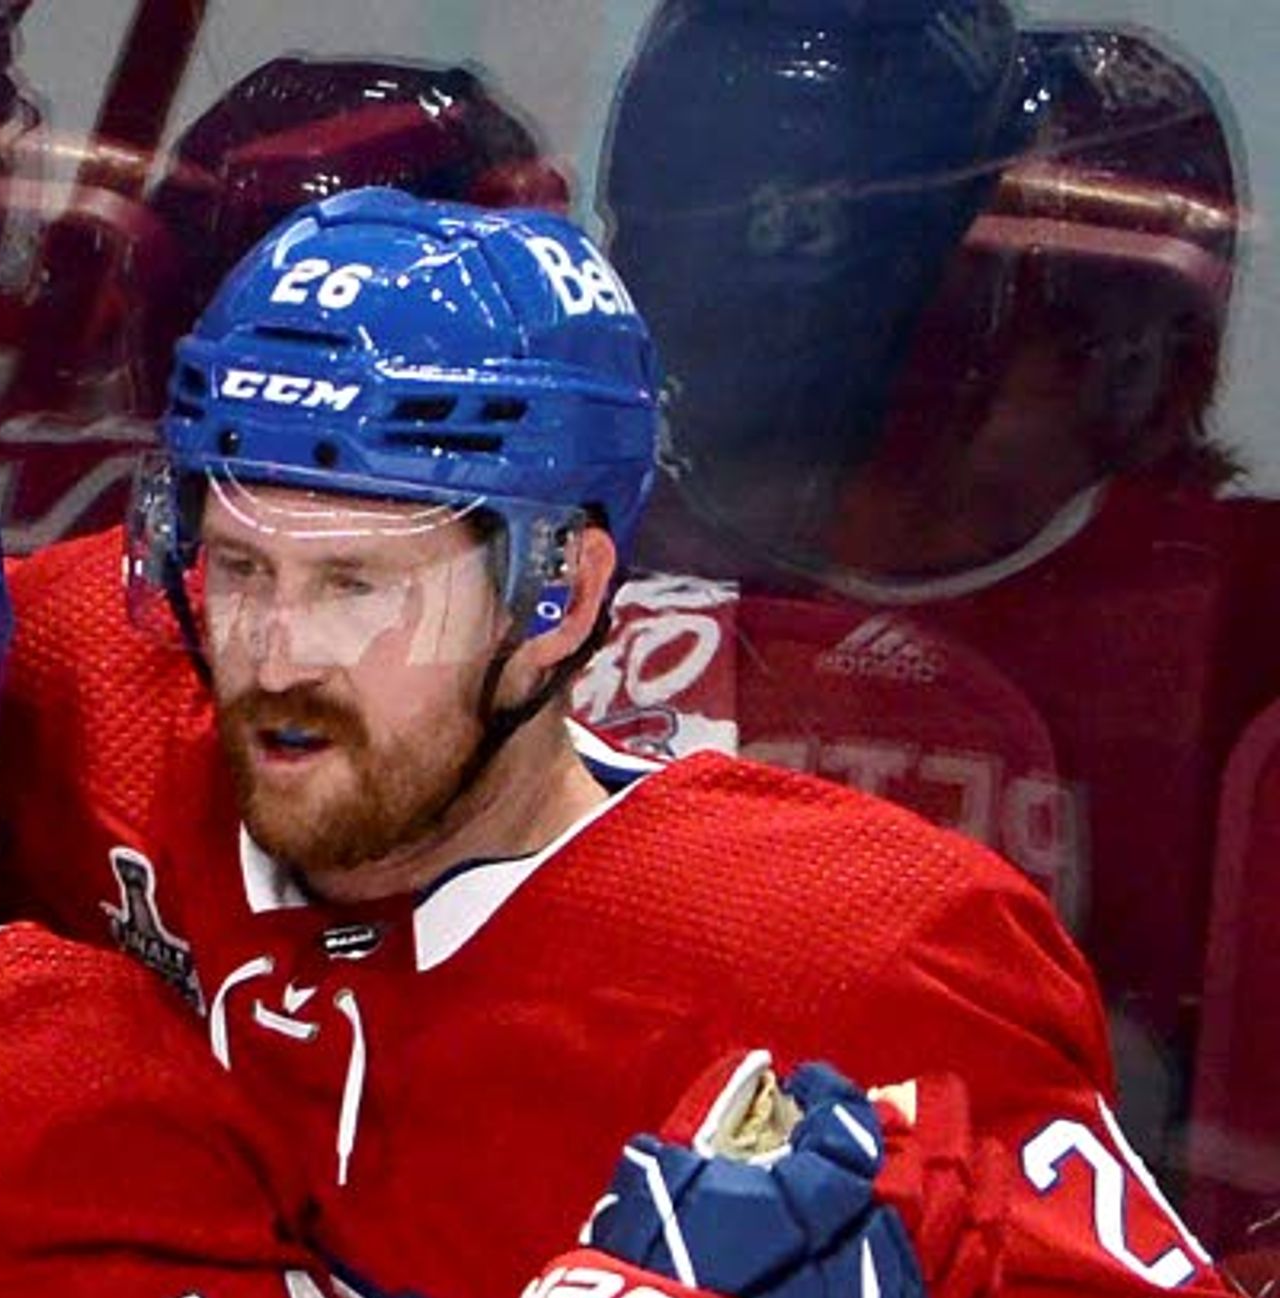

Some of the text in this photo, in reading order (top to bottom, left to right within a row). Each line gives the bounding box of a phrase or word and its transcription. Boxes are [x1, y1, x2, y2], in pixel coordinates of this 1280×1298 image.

[269, 259, 371, 310] 26
[219, 369, 360, 411] CCM
[1020, 1093, 1212, 1290] 2
